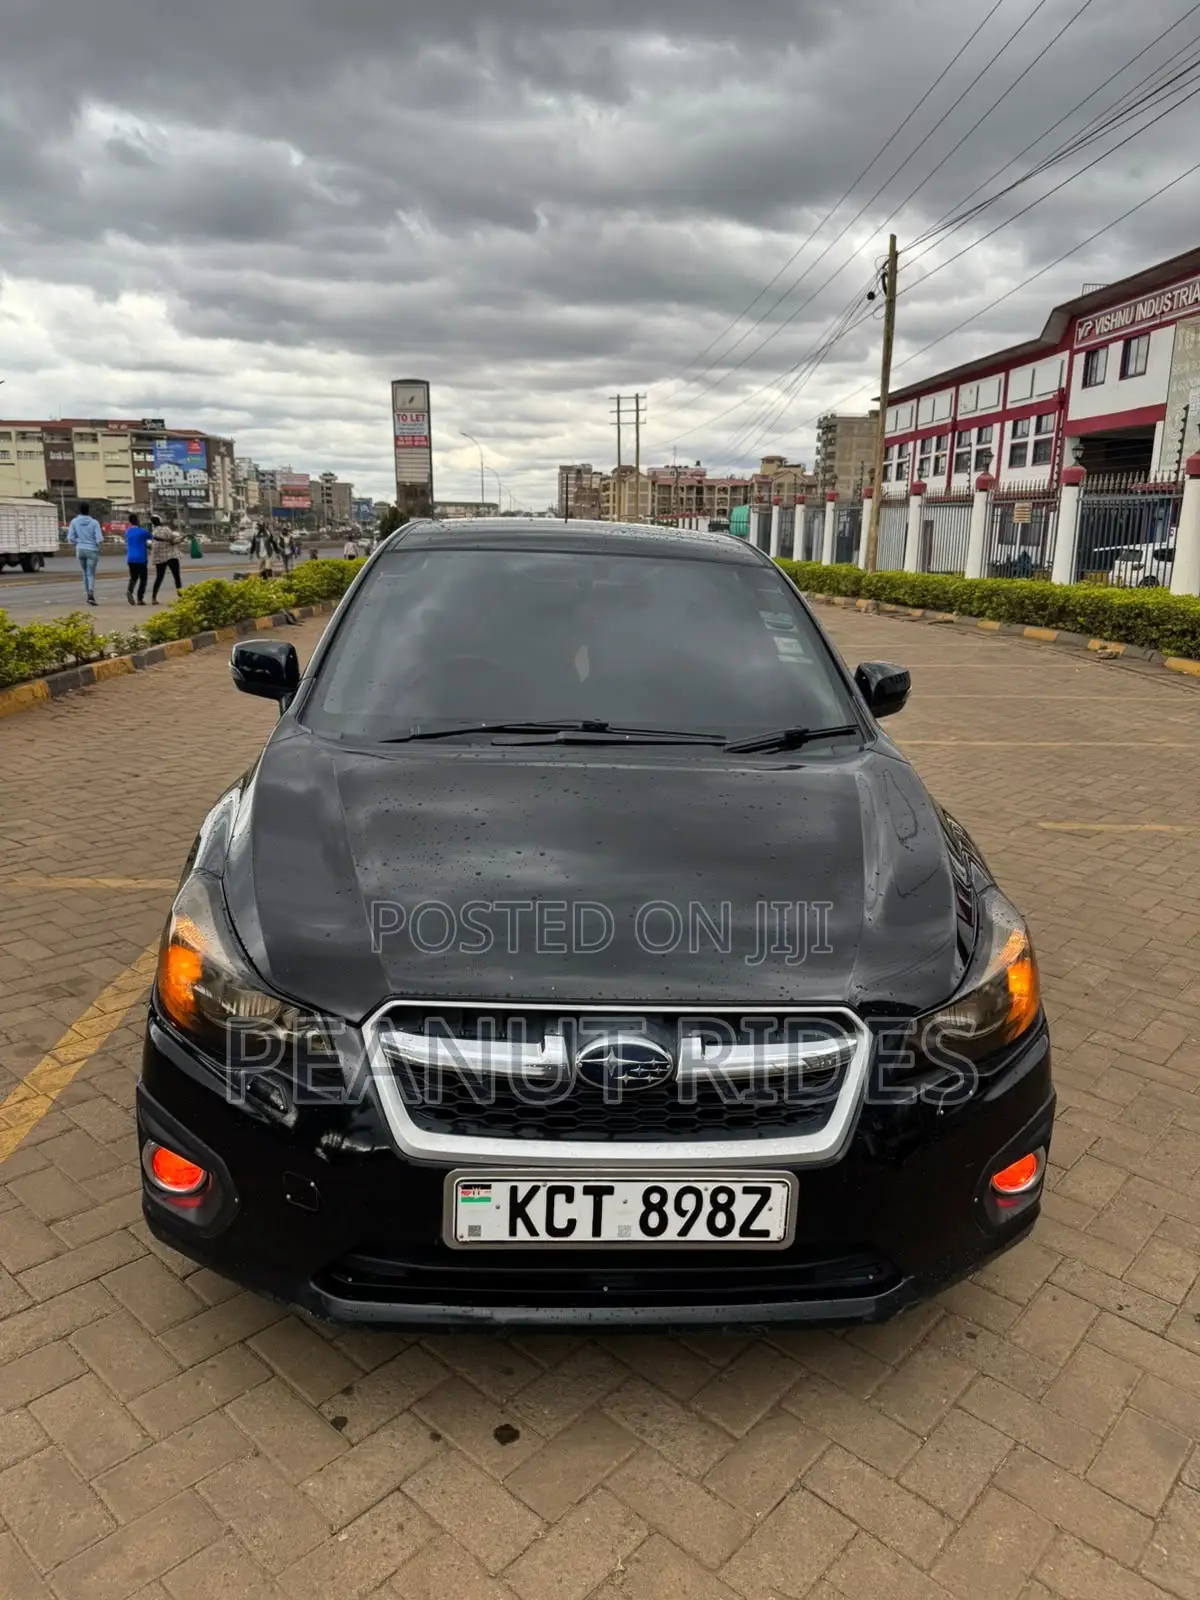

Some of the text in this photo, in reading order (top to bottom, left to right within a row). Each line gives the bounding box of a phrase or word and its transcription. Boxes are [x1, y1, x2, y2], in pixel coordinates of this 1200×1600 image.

[1094, 305, 1136, 335] VISHNU
[396, 413, 426, 422] TO LET
[508, 1184, 615, 1238] KCT
[639, 1184, 773, 1238] 898Z
